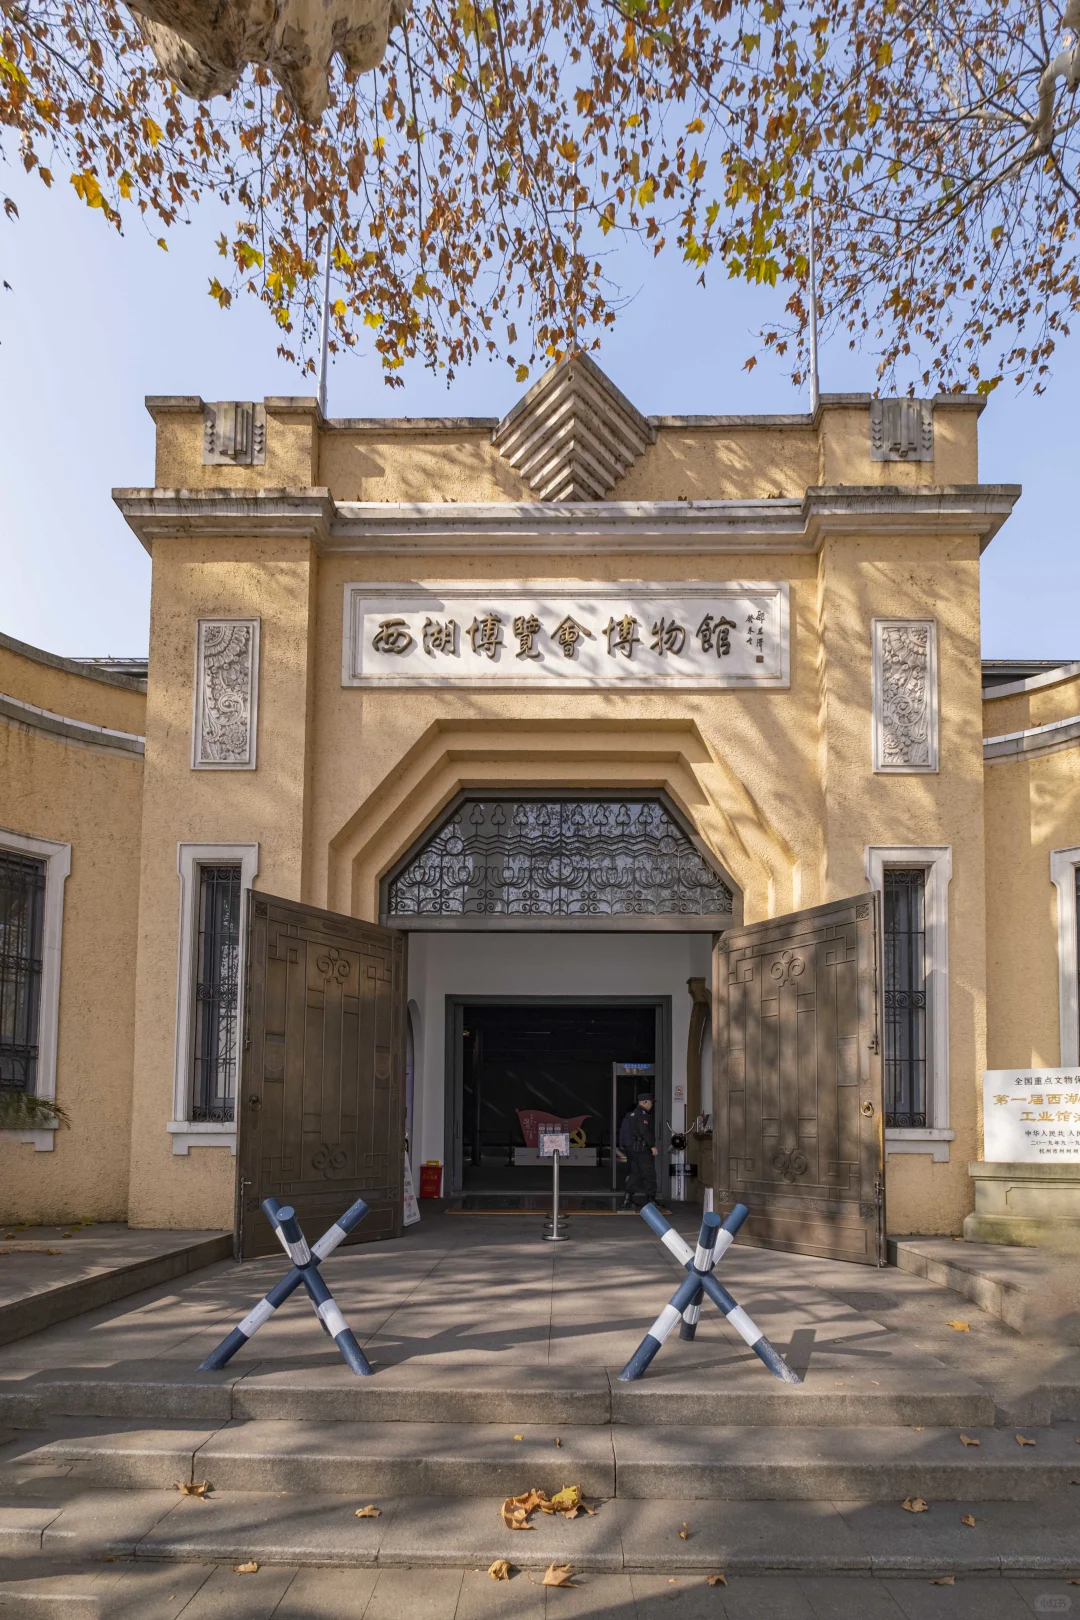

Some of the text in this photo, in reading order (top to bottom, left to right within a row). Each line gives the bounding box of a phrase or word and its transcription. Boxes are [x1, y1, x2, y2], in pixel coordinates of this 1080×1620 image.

[372, 613, 737, 660] 西湖博覽會博物館
